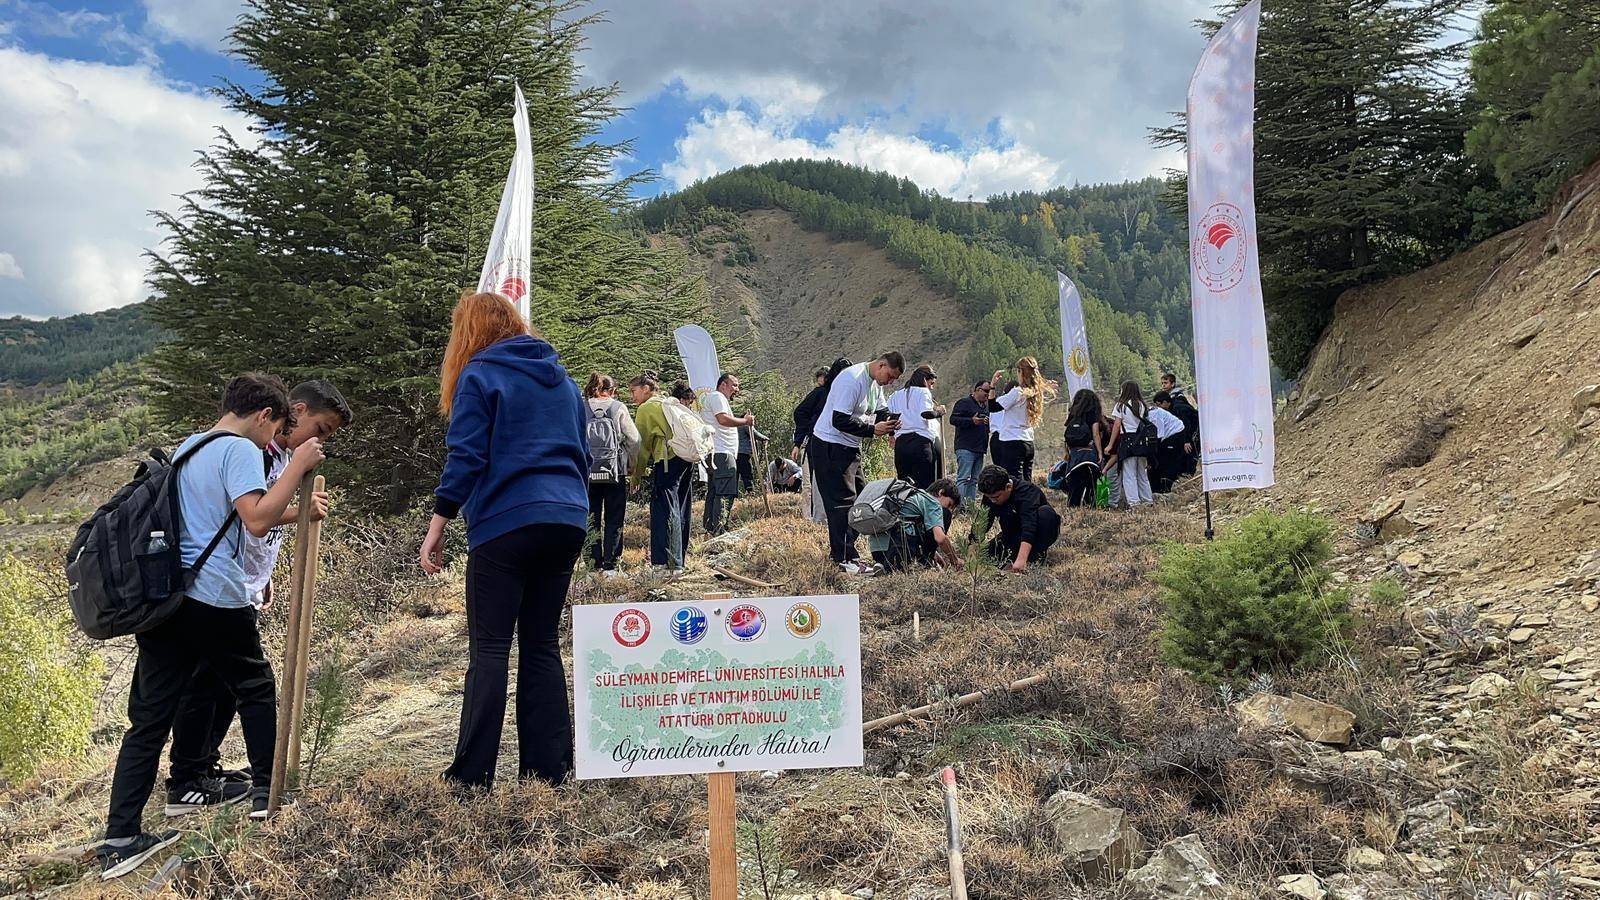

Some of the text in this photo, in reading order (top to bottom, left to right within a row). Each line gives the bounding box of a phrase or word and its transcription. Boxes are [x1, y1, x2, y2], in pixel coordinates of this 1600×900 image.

[595, 664, 845, 687] SÜLEYMAN DEMİREL ÜNİVERSİTESİ HALKLA
[621, 685, 821, 711] İLİŞKİLER VE TANITIM BÖLÜMÜ İLE
[659, 711, 787, 728] ATATÜRK ORTAOKULU
[612, 729, 831, 773] Öğrencilerinden Hatıra!
